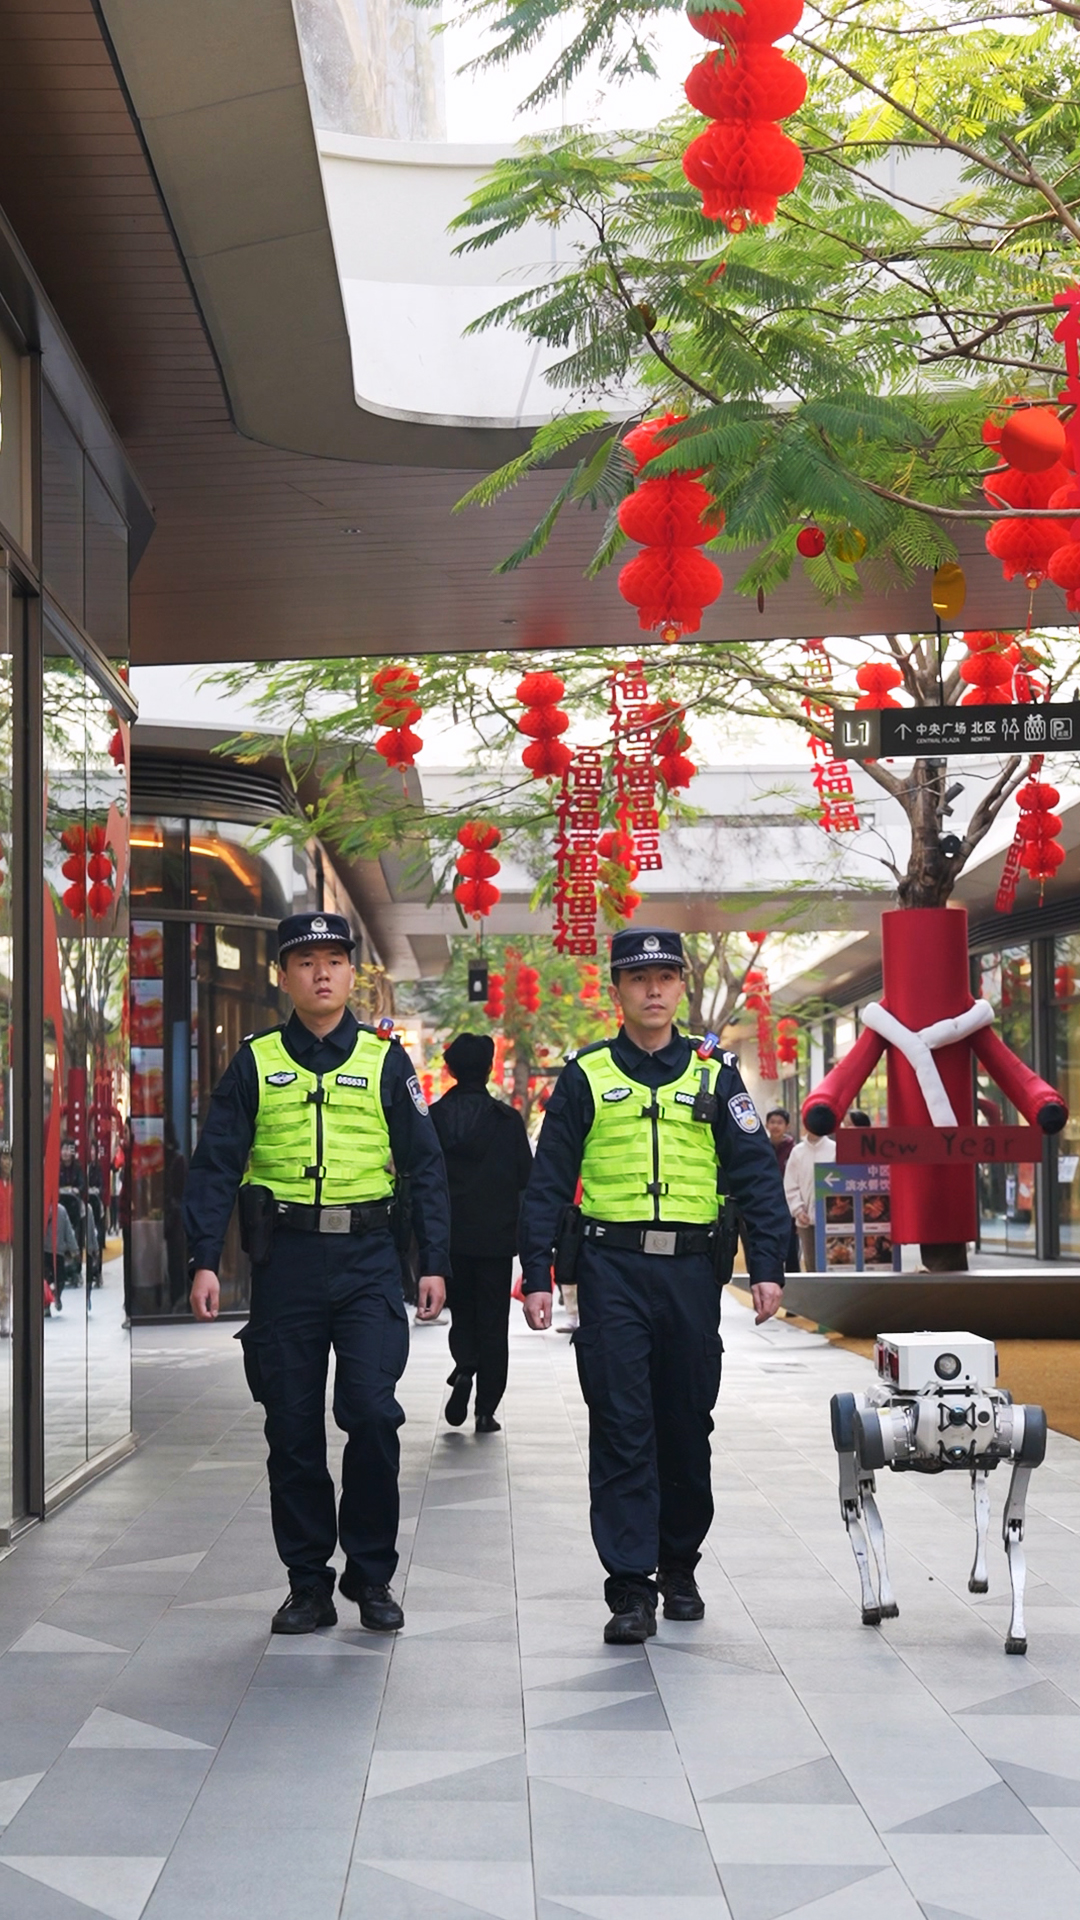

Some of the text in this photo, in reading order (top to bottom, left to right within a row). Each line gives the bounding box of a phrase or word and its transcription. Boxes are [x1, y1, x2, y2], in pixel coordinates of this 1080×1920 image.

[842, 720, 870, 746] L1
[916, 720, 997, 736] 中央广场 北区
[860, 1132, 1015, 1158] New Year
